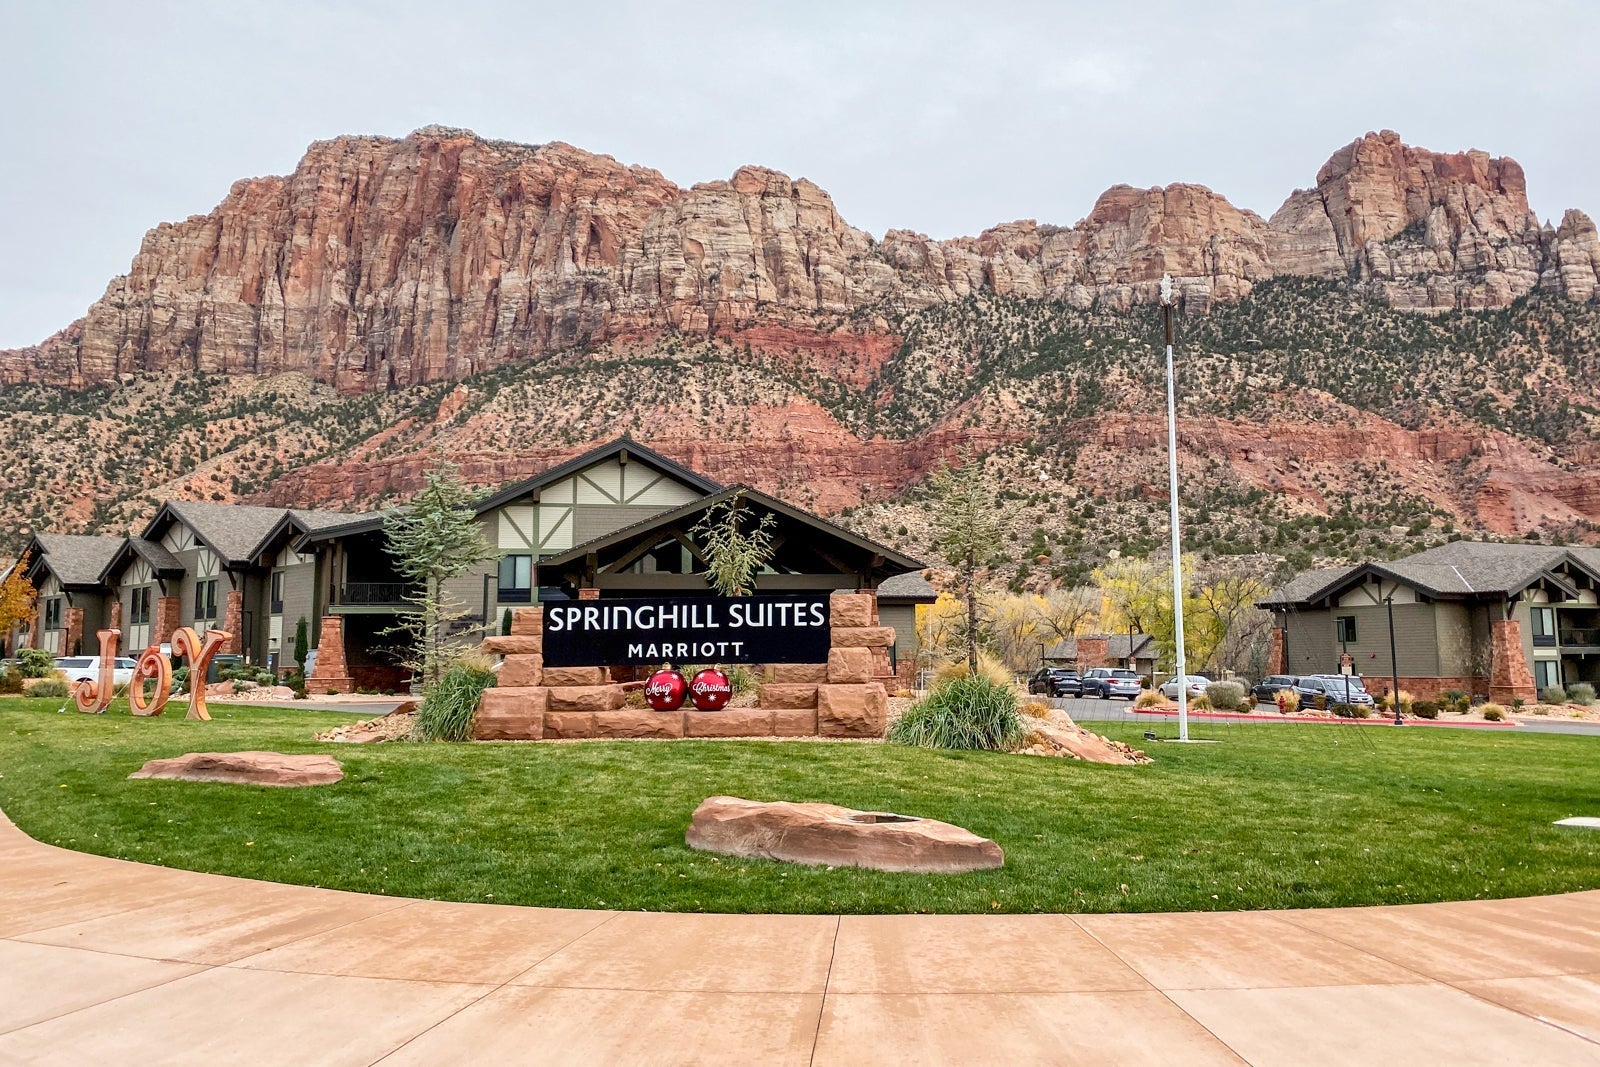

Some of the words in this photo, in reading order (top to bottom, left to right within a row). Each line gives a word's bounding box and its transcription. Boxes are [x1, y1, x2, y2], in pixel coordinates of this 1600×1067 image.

[548, 604, 720, 632] SPRINGHILL
[728, 602, 825, 628] SUITES
[627, 641, 744, 658] MARRIOTT
[75, 626, 233, 721] JOY
[645, 682, 673, 697] Merry
[692, 681, 731, 696] Christmas
